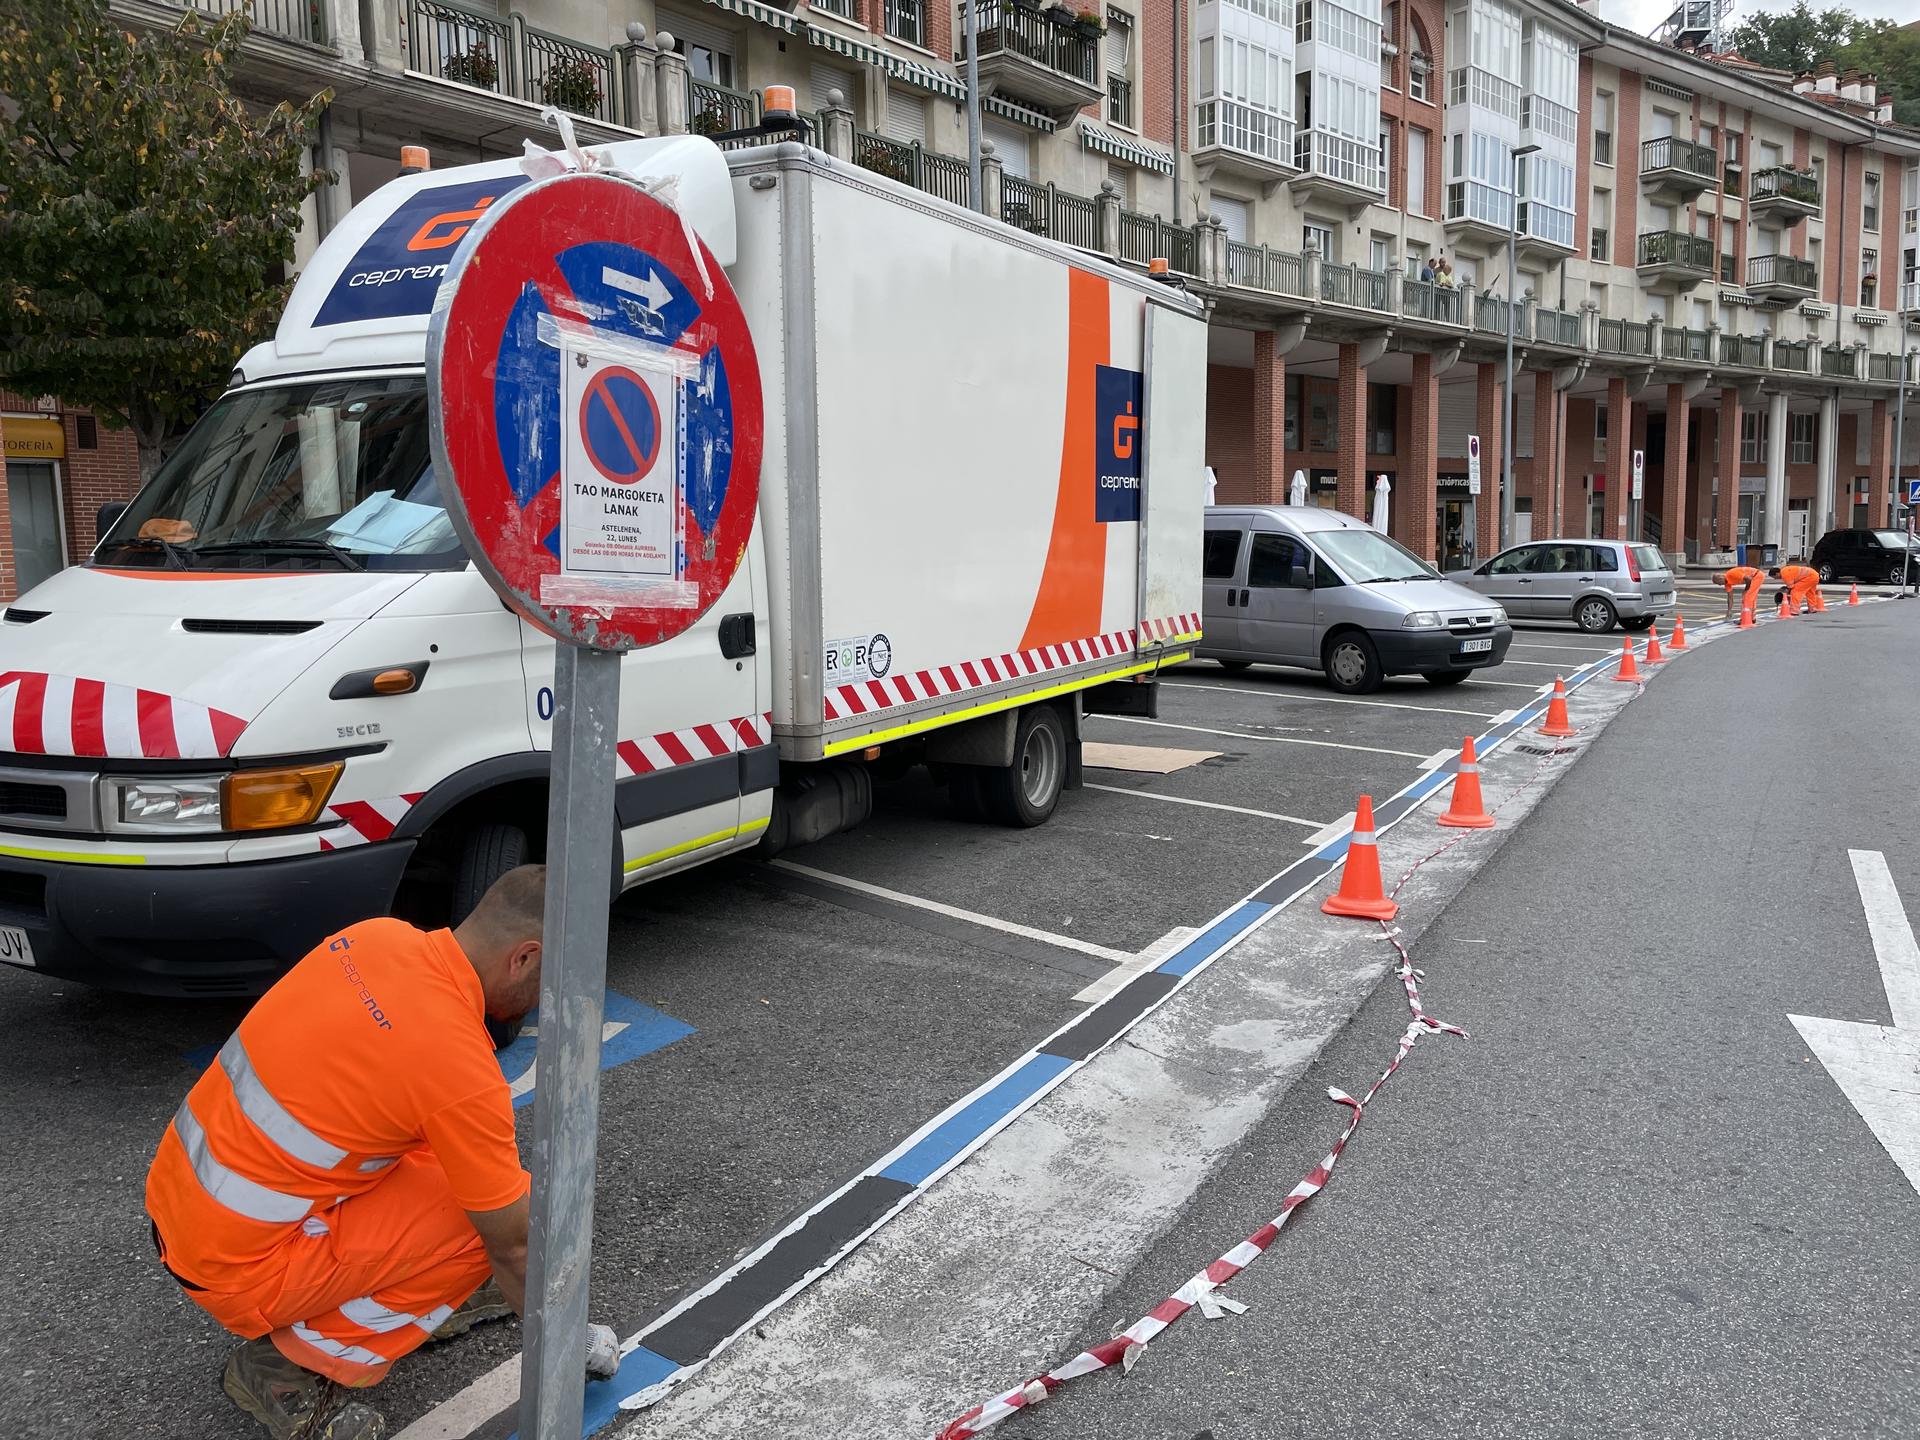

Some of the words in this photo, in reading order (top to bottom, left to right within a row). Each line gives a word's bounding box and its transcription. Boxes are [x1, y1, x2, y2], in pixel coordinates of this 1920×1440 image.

[574, 483, 598, 497] TAO
[601, 486, 665, 504] MARGOKETA
[604, 503, 639, 517] LANAK
[601, 524, 642, 535] ASTELEHENA,
[618, 535, 638, 543] LUNES
[340, 954, 392, 1030] ceprenor
